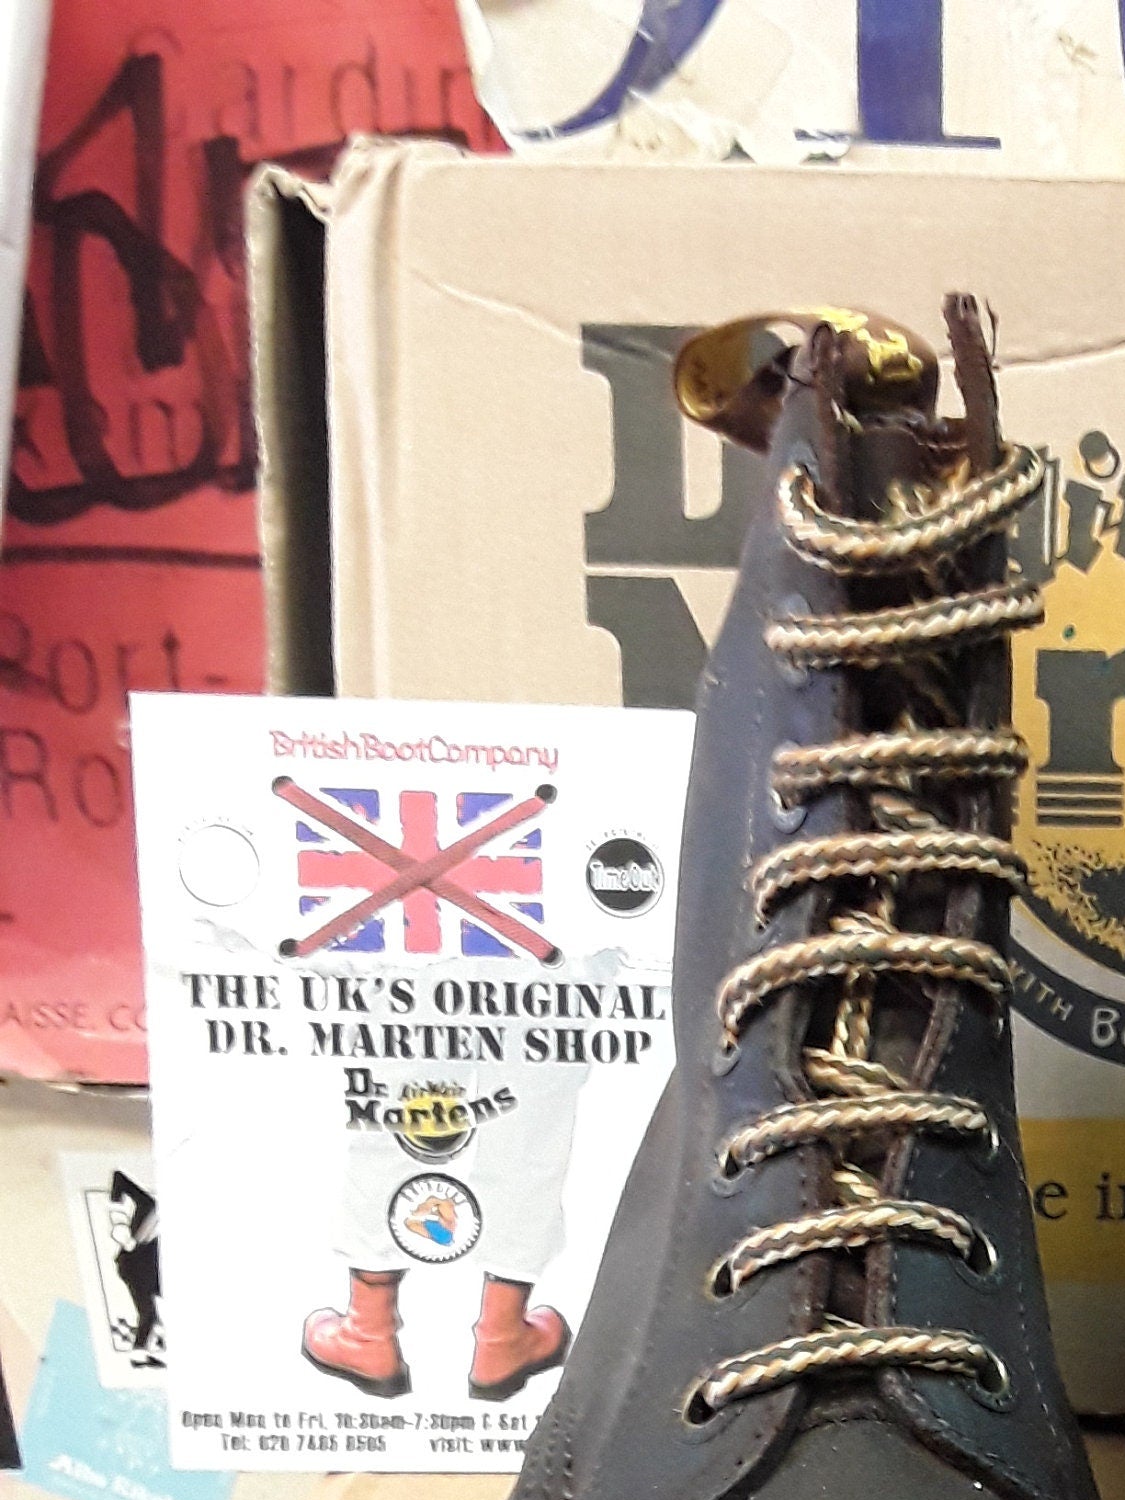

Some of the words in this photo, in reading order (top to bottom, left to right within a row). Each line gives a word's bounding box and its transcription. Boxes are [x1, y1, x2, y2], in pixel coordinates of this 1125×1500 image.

[181, 972, 281, 1010] THE
[301, 976, 415, 1017] UK'S
[433, 979, 667, 1022] ORIGINAL
[205, 1020, 288, 1056] DR.
[310, 1022, 505, 1063] MARTEN
[525, 1029, 652, 1066] SHOP
[344, 1086, 519, 1132] Martens
